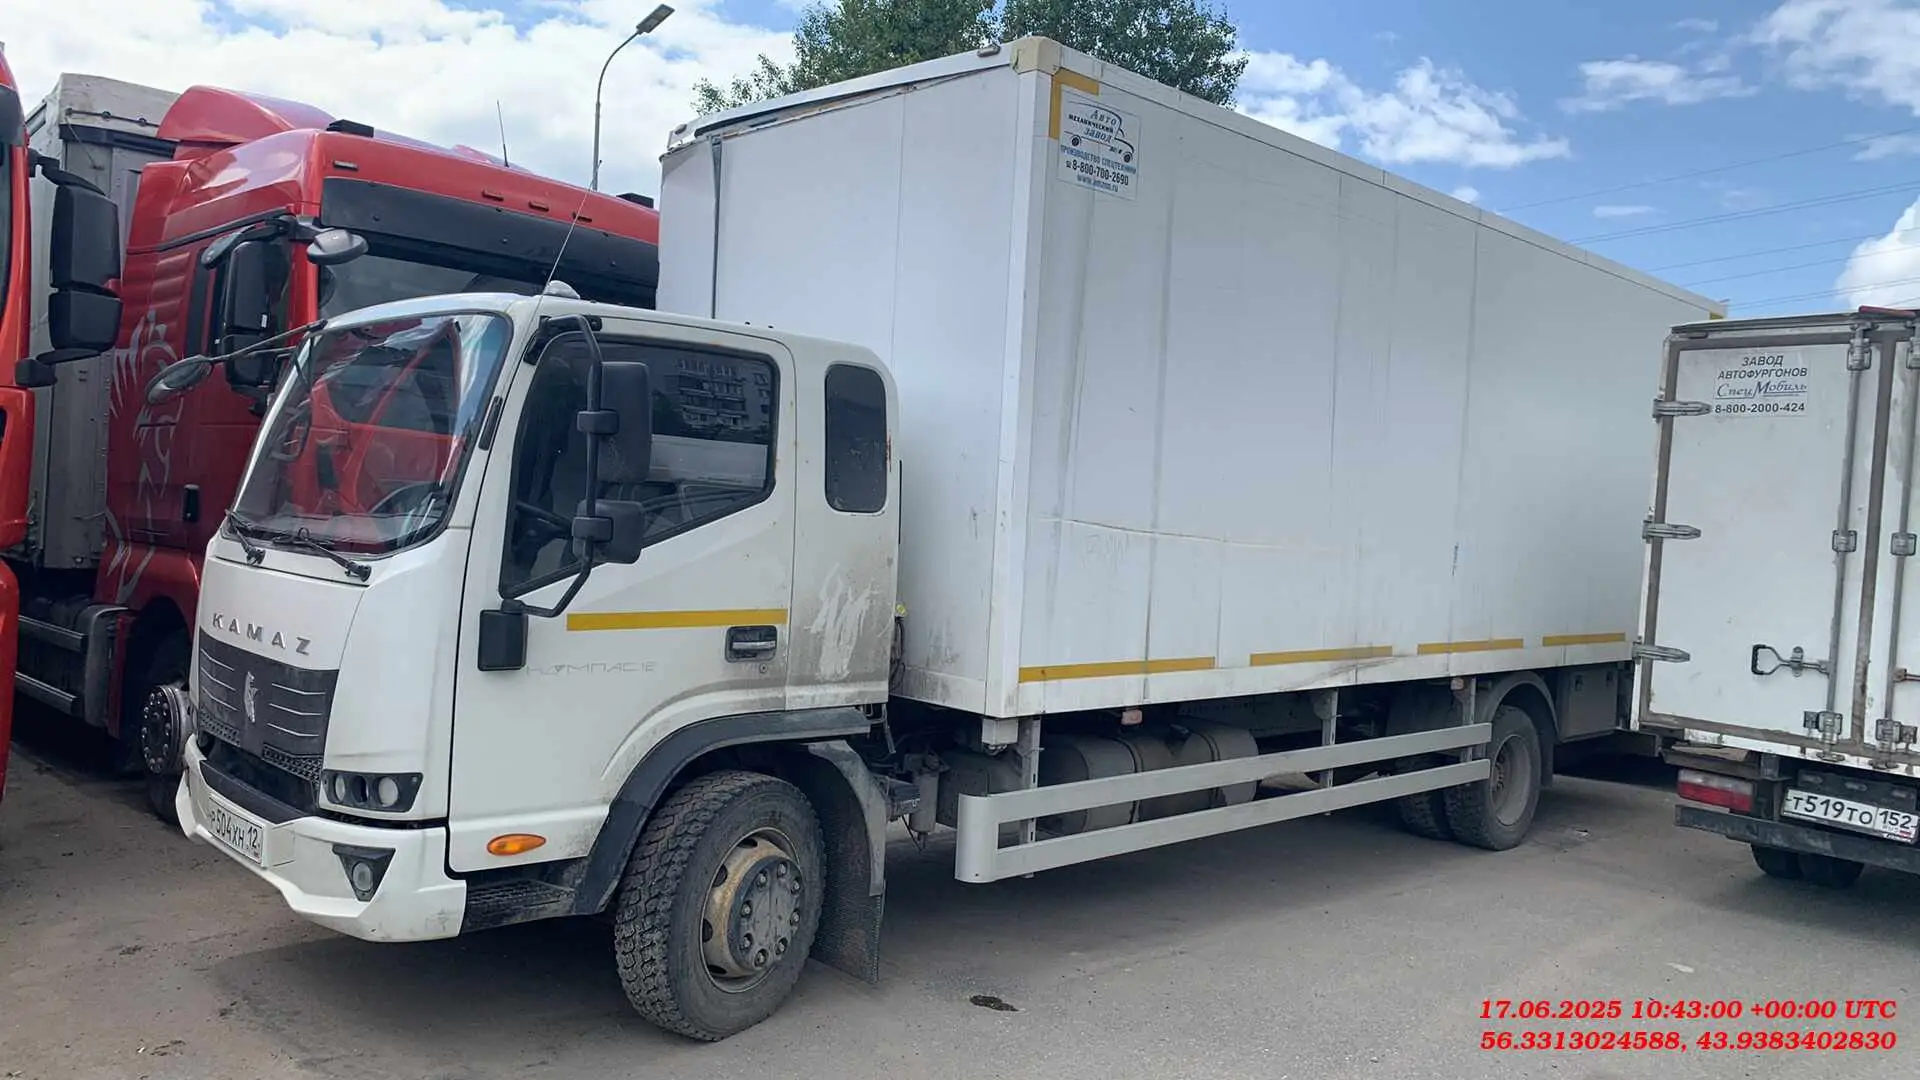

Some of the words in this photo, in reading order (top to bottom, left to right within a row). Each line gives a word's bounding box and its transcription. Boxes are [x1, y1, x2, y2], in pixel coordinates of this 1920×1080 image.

[1060, 144, 1101, 163] ПРОИЗВОДСТВО
[1072, 159, 1129, 186] 8-800-700-2690
[1741, 355, 1784, 368] ЗАВОД
[1717, 367, 1808, 380] АВТОФУРГОНОВ
[1714, 402, 1805, 414] 8-800-2000-424
[211, 612, 311, 656] KAMAZ
[1792, 795, 1873, 825] Т519ТО
[1879, 810, 1912, 830] 152
